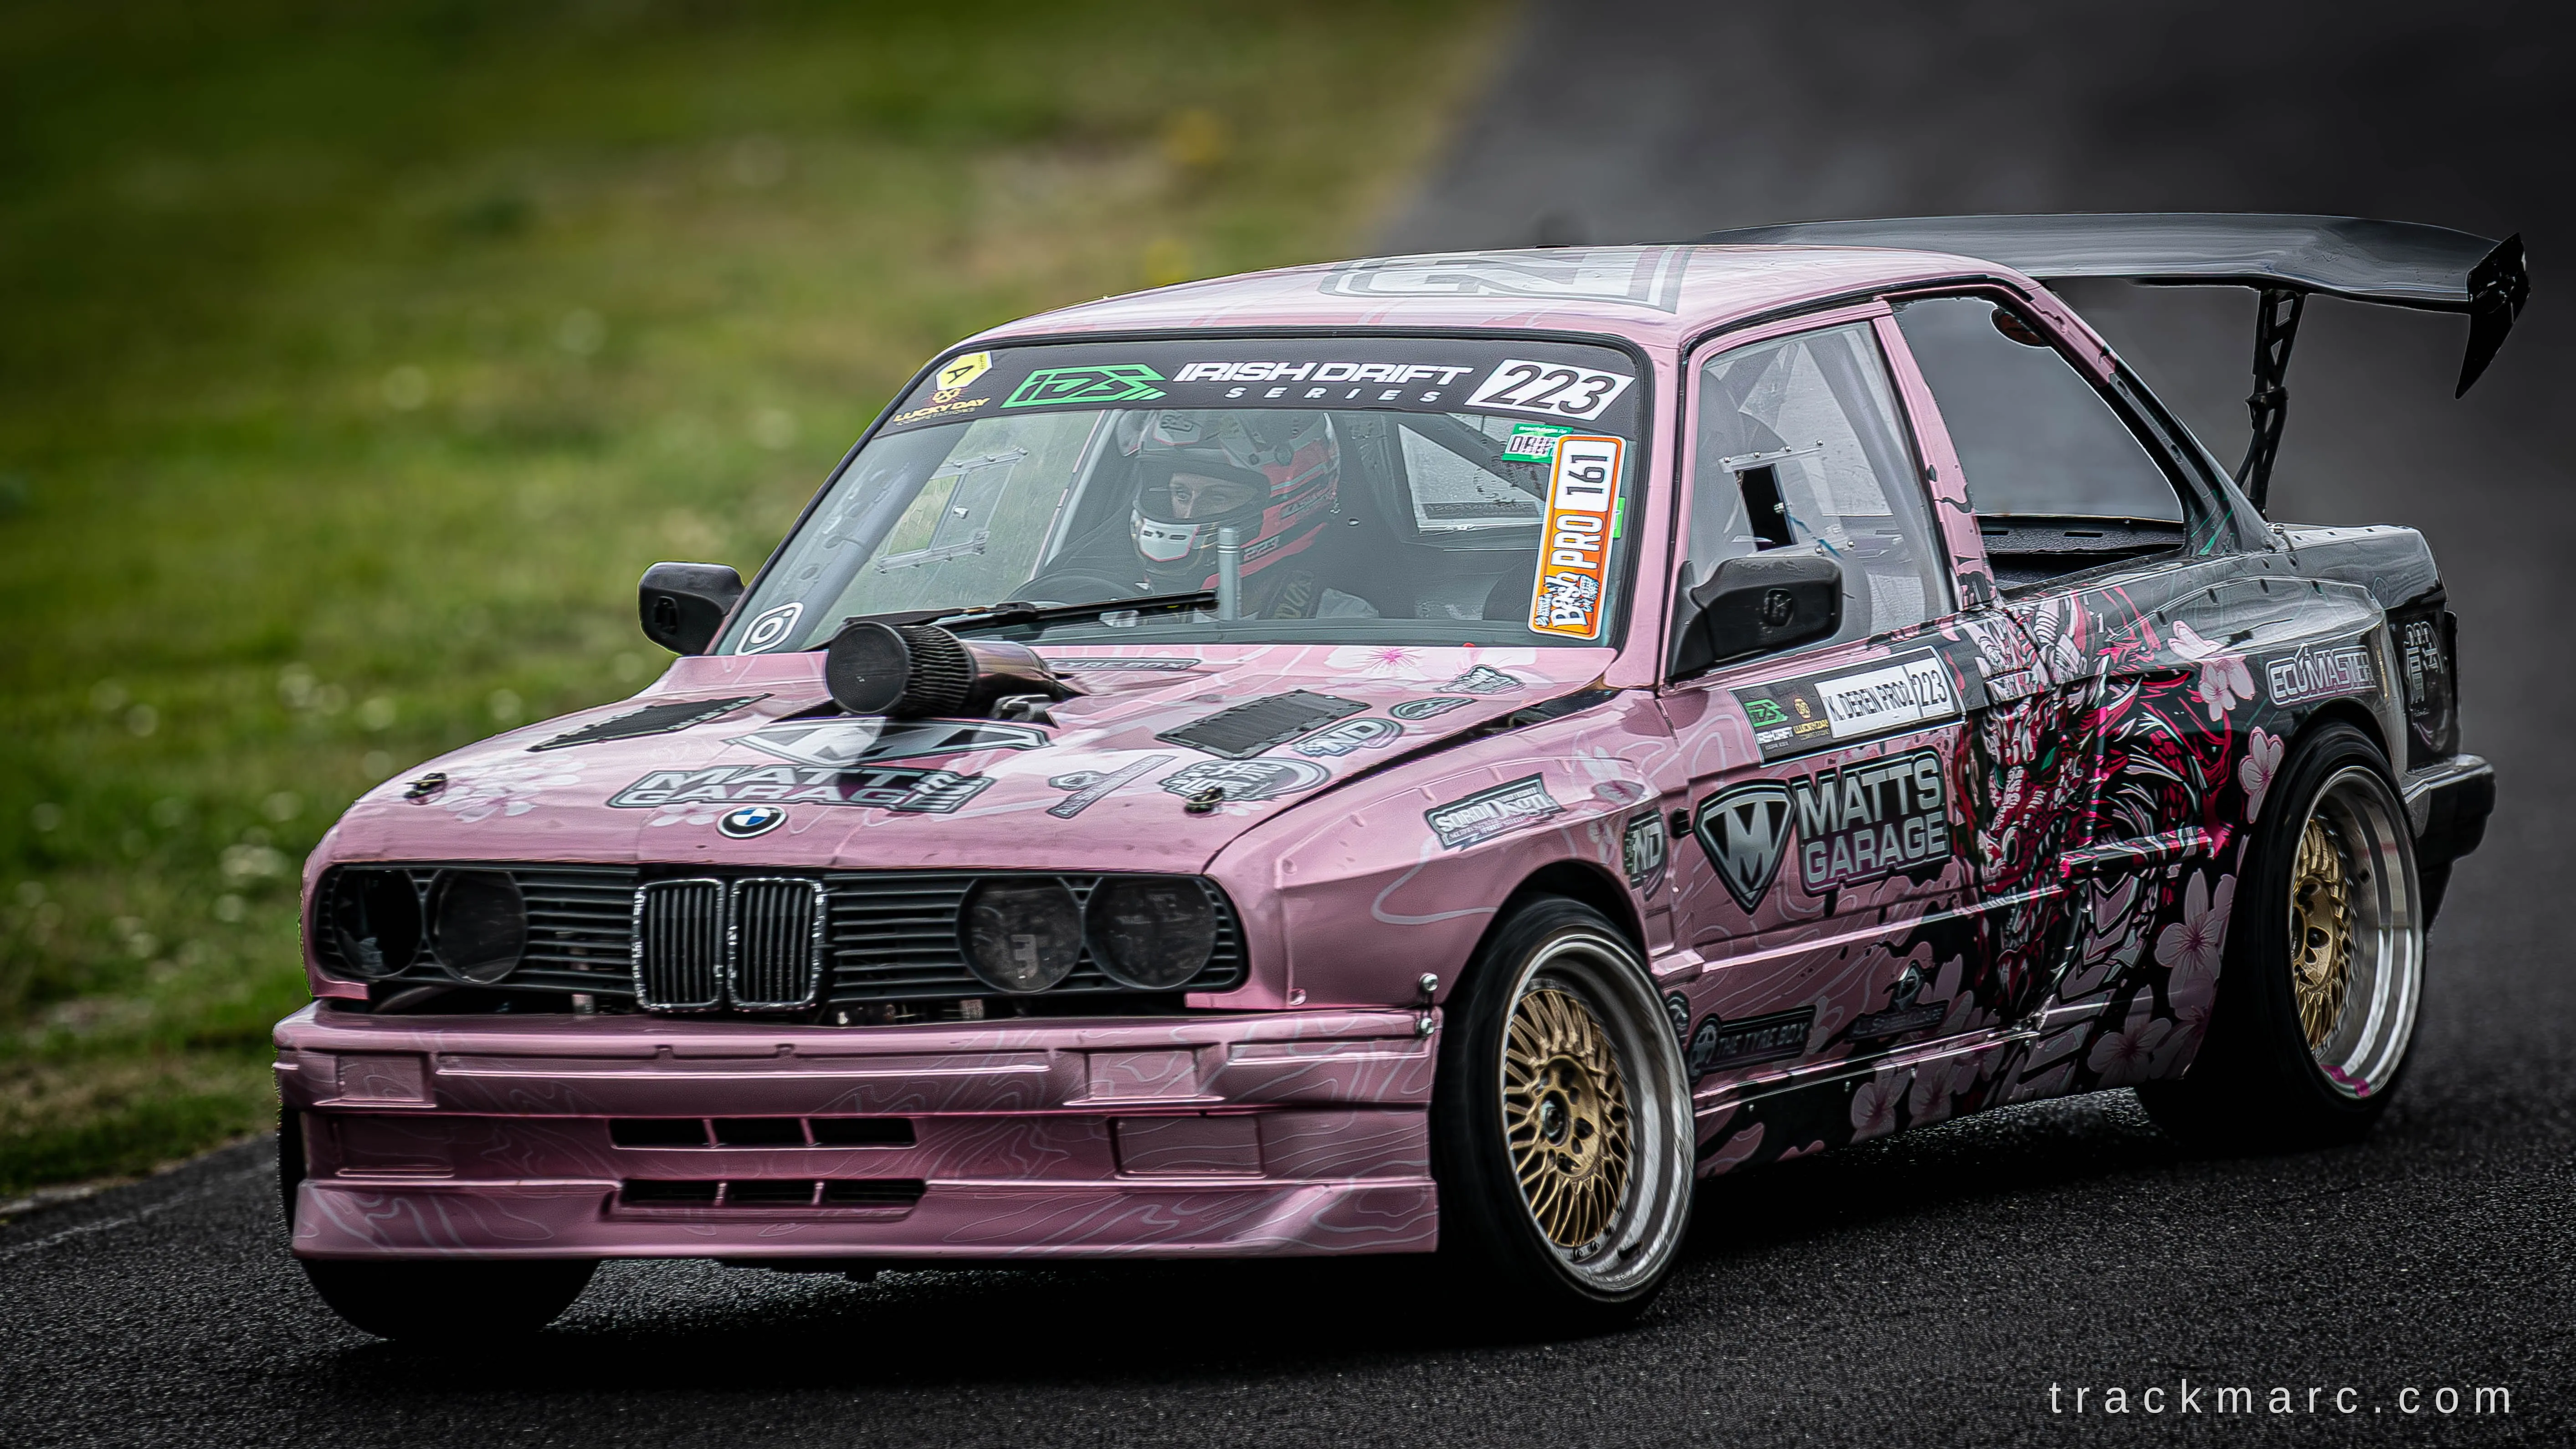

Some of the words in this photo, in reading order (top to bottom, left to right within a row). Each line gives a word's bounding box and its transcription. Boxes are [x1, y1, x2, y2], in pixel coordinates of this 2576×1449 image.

[1173, 362, 1318, 382] IRISH
[1309, 362, 1474, 386] DRIFT
[1479, 364, 1616, 414] 223
[950, 397, 991, 410] DAY
[1224, 386, 1442, 403] SERIES
[1565, 454, 1608, 495] 161
[1551, 514, 1604, 569] PRO
[1910, 669, 1948, 706] 223
[635, 766, 982, 794] MATTS
[619, 785, 956, 812] GARAGE
[1795, 758, 1942, 840] MATTS
[1805, 811, 1947, 884] GARAGE
[1777, 1022, 1809, 1046] BOX
